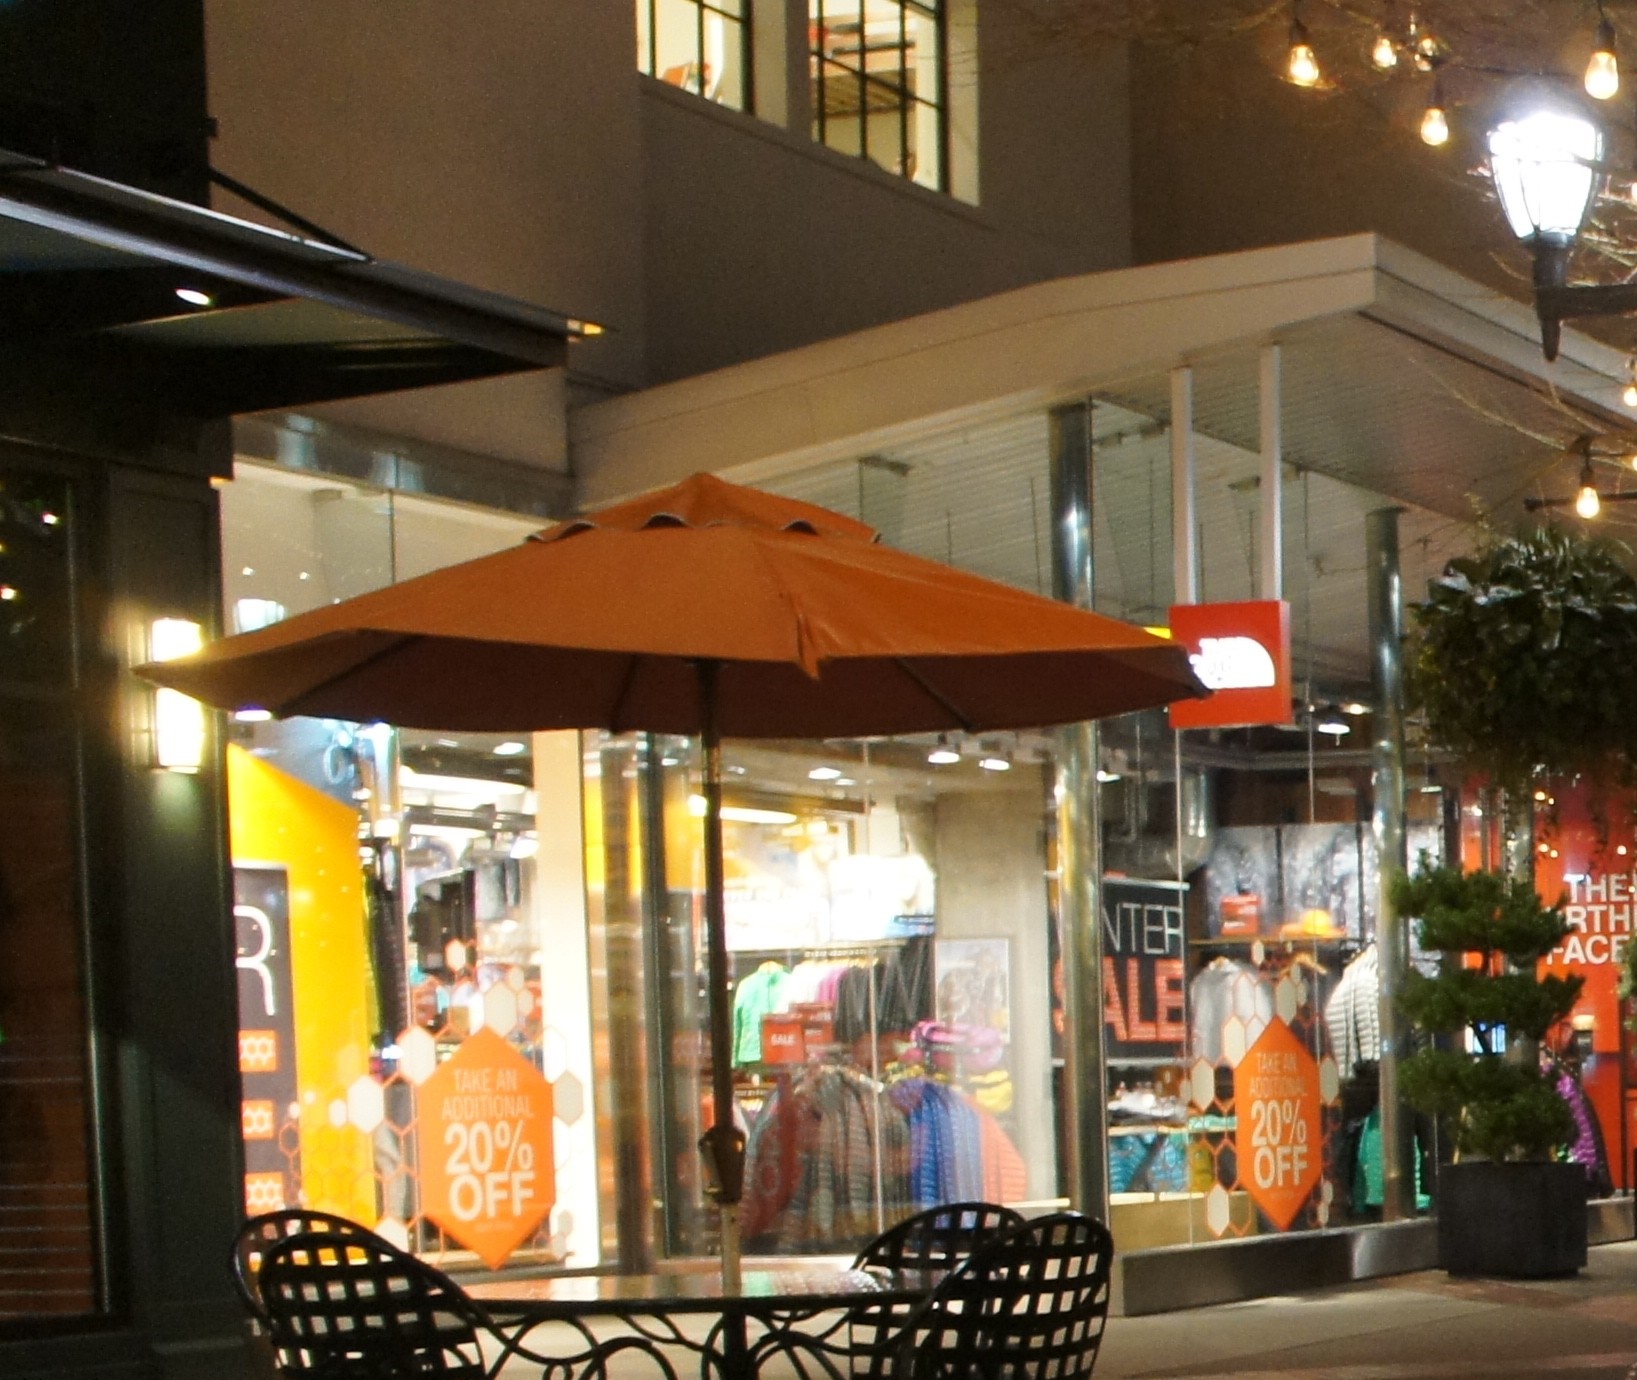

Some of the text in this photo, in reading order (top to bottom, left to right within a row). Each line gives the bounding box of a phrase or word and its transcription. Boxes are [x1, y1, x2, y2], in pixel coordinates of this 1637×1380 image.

[1563, 872, 1630, 903] THE
[1103, 902, 1182, 953] NTER
[1545, 904, 1630, 934] RTH
[454, 1067, 519, 1093] TAKE AN
[441, 1094, 534, 1120] ADDITIONAL
[1250, 1099, 1307, 1147] 20%
[444, 1120, 534, 1176] 20%
[1253, 1144, 1309, 1189] OFF
[449, 1171, 536, 1222] OFF
